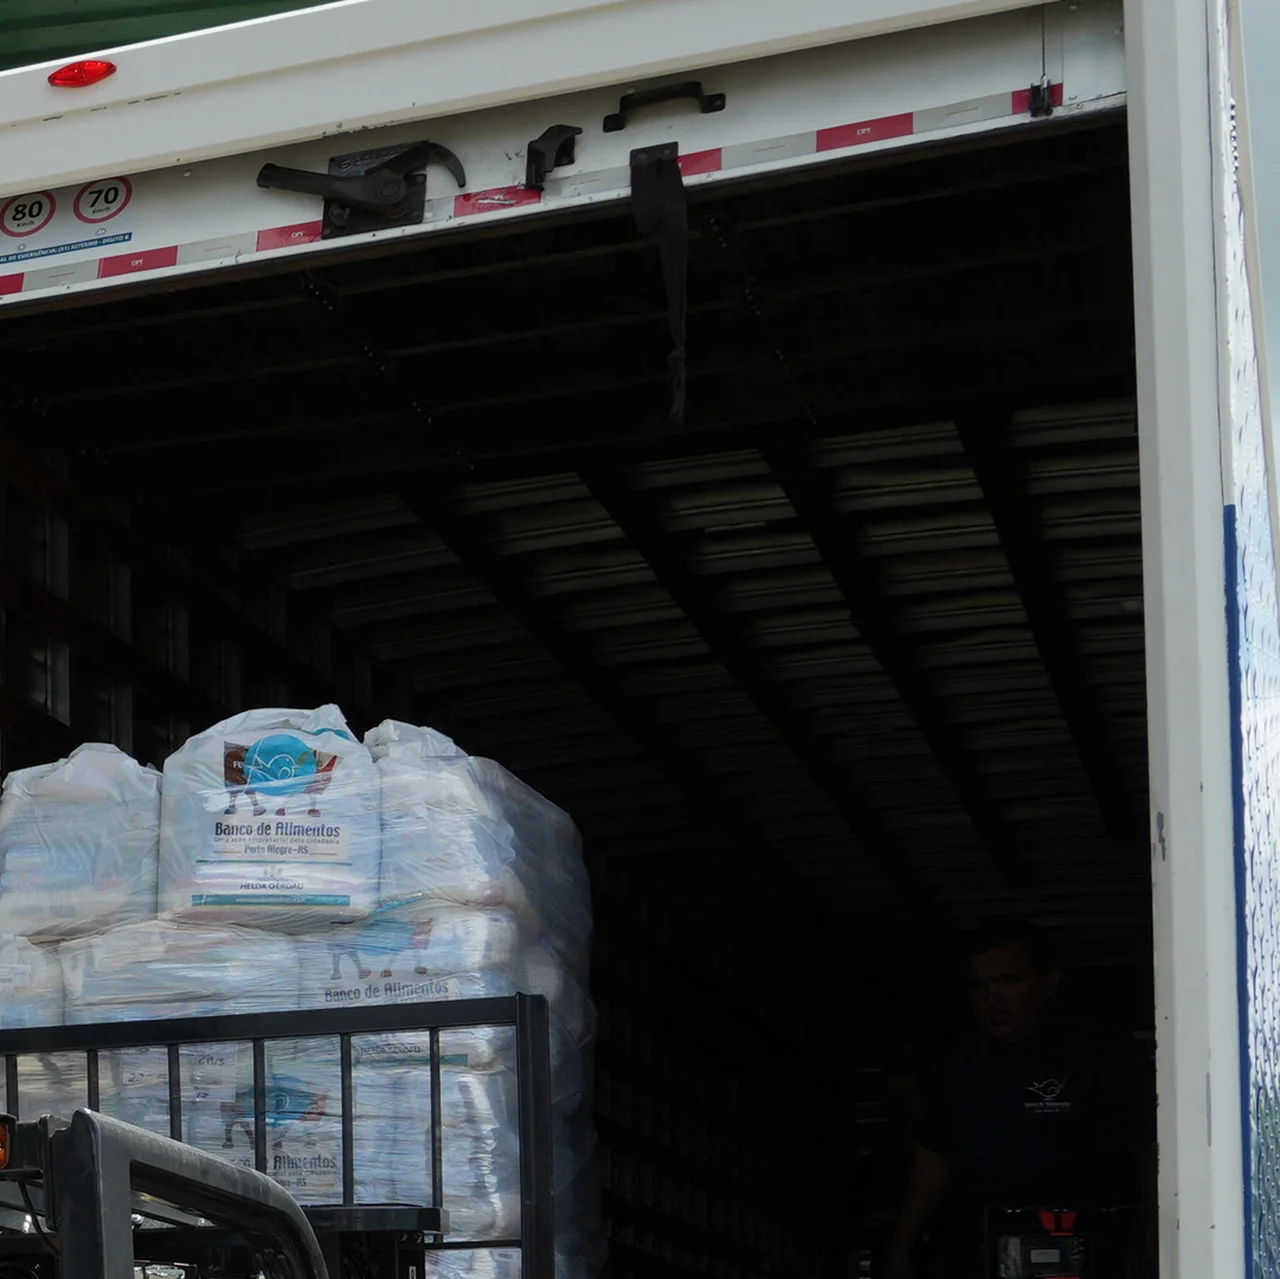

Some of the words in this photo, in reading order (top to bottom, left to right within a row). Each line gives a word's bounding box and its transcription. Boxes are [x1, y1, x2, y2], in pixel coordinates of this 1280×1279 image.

[88, 186, 120, 208] 70
[11, 201, 44, 222] 80
[215, 821, 253, 836] Banco
[256, 821, 272, 836] de
[275, 821, 341, 838] Alimentos
[324, 987, 361, 1003] Banco
[364, 984, 380, 999] de
[384, 979, 449, 998] Alimentos
[273, 1153, 337, 1170] Alimentos
